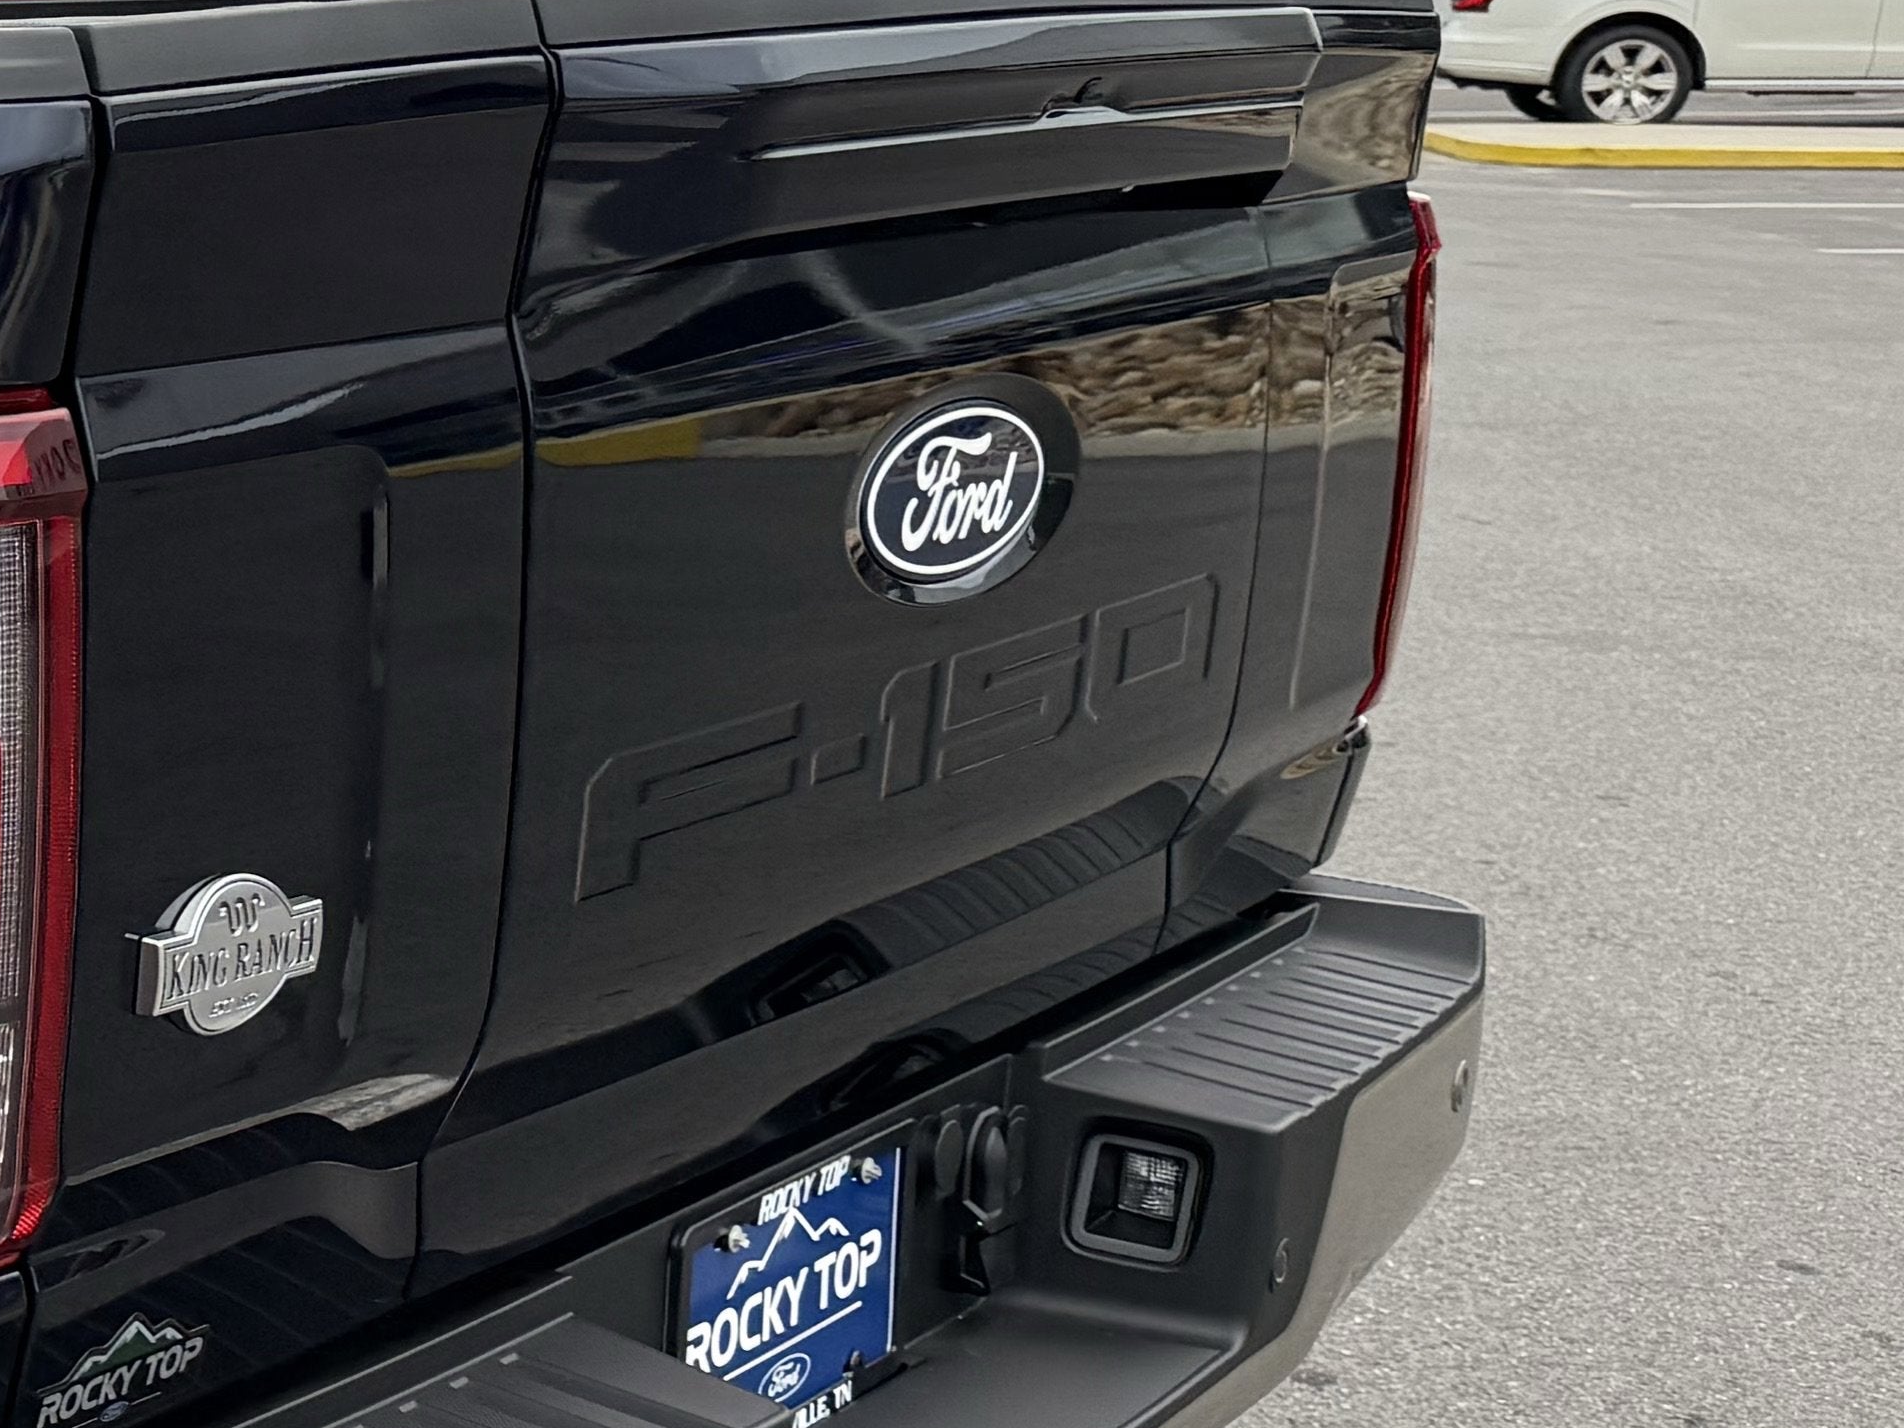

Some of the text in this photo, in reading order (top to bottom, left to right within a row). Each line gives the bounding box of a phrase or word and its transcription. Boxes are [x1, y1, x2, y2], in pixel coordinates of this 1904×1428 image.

[900, 431, 1019, 552] Ford
[573, 572, 1221, 905] F-150
[165, 917, 318, 1001] KING RANCH
[757, 1154, 851, 1226] ROCKY TOP
[685, 1228, 883, 1373] ROCKY TOP
[145, 1336, 204, 1386] TOP
[832, 1379, 853, 1410] TN
